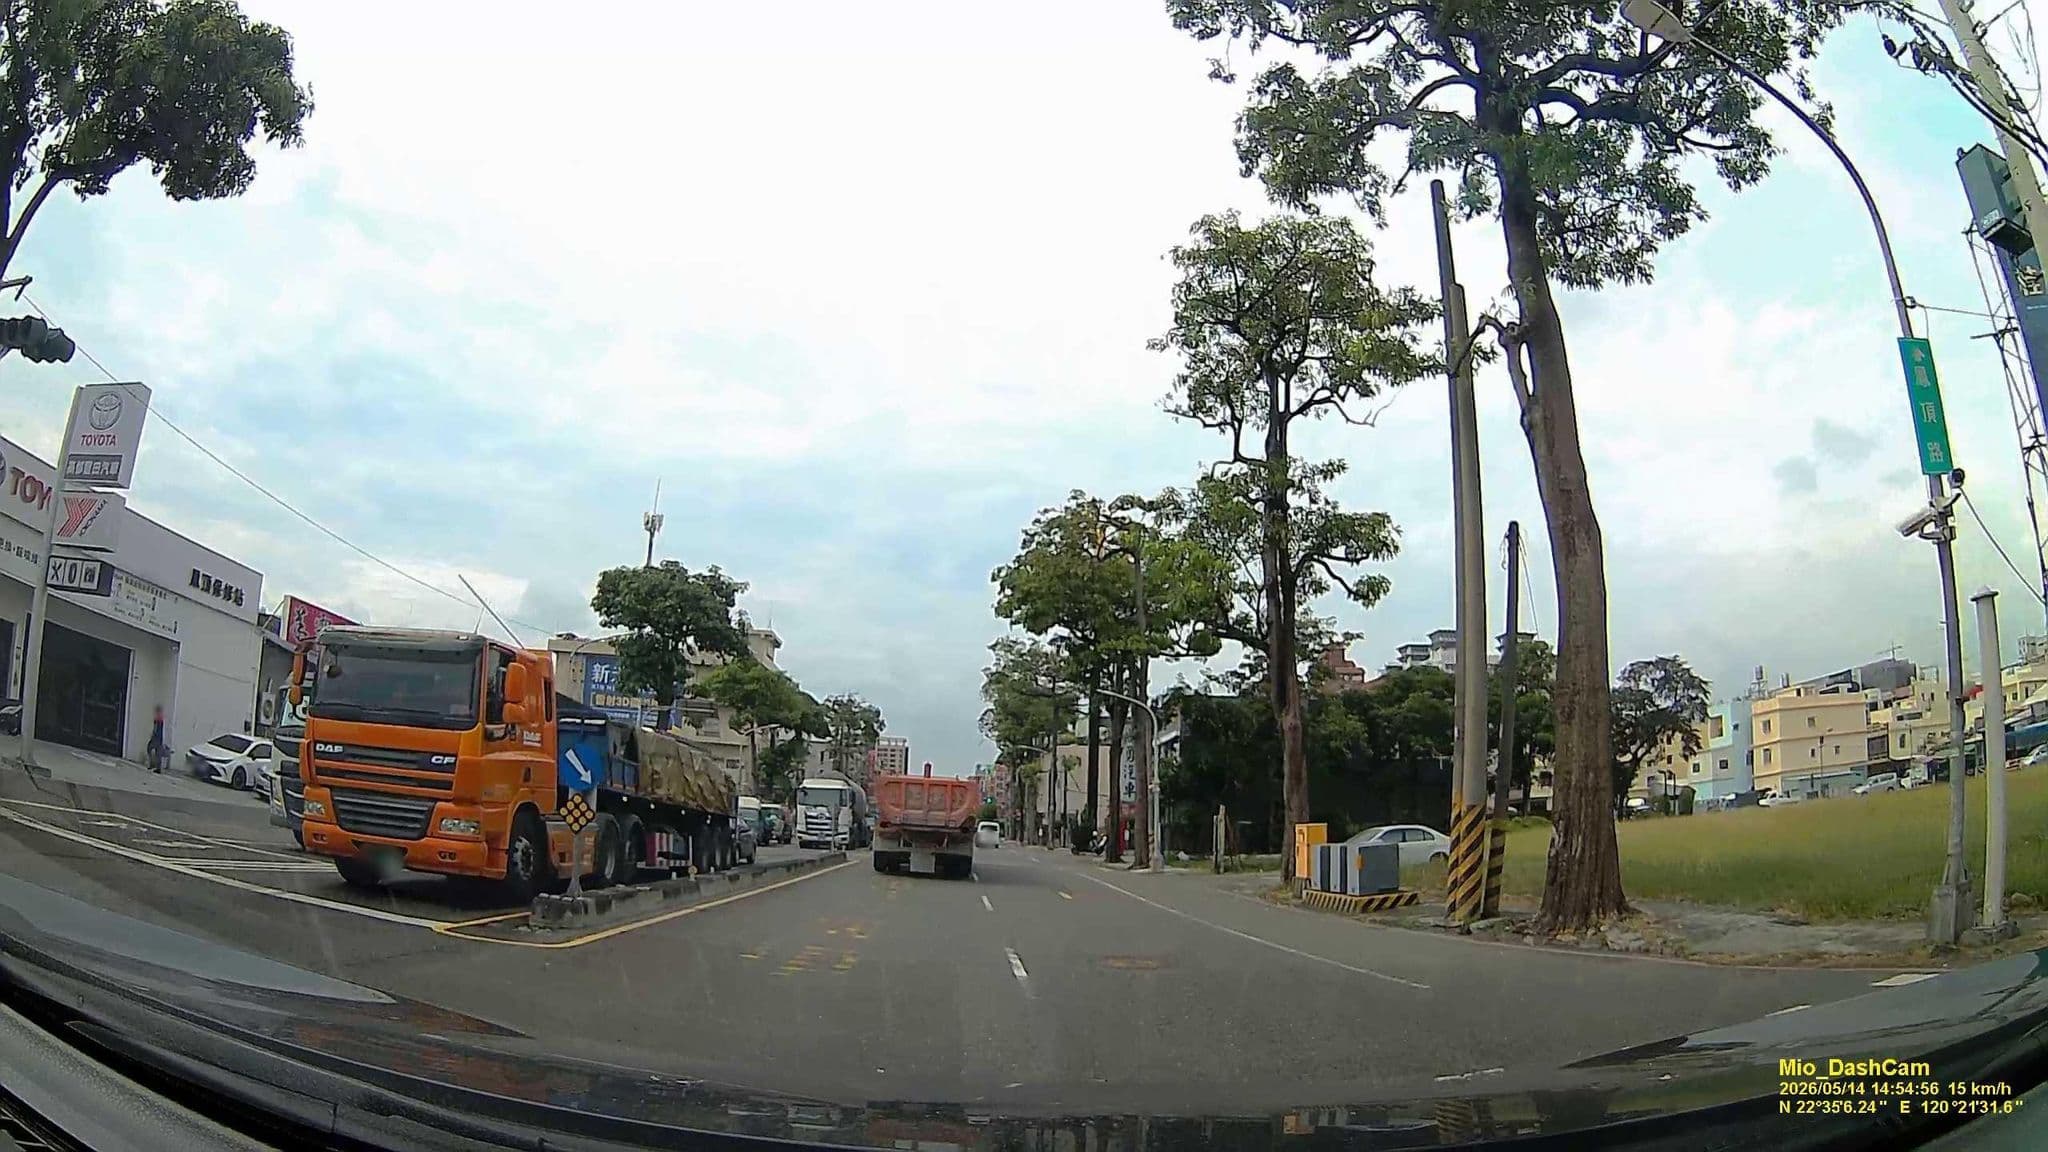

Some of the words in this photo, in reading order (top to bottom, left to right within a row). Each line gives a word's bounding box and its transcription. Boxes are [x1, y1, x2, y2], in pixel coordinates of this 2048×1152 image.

[1913, 365, 1944, 463] 鳳頂路
[80, 434, 117, 447] TOYOTA
[10, 466, 53, 511] TOY
[315, 743, 344, 753] DAF
[431, 755, 457, 764] CF
